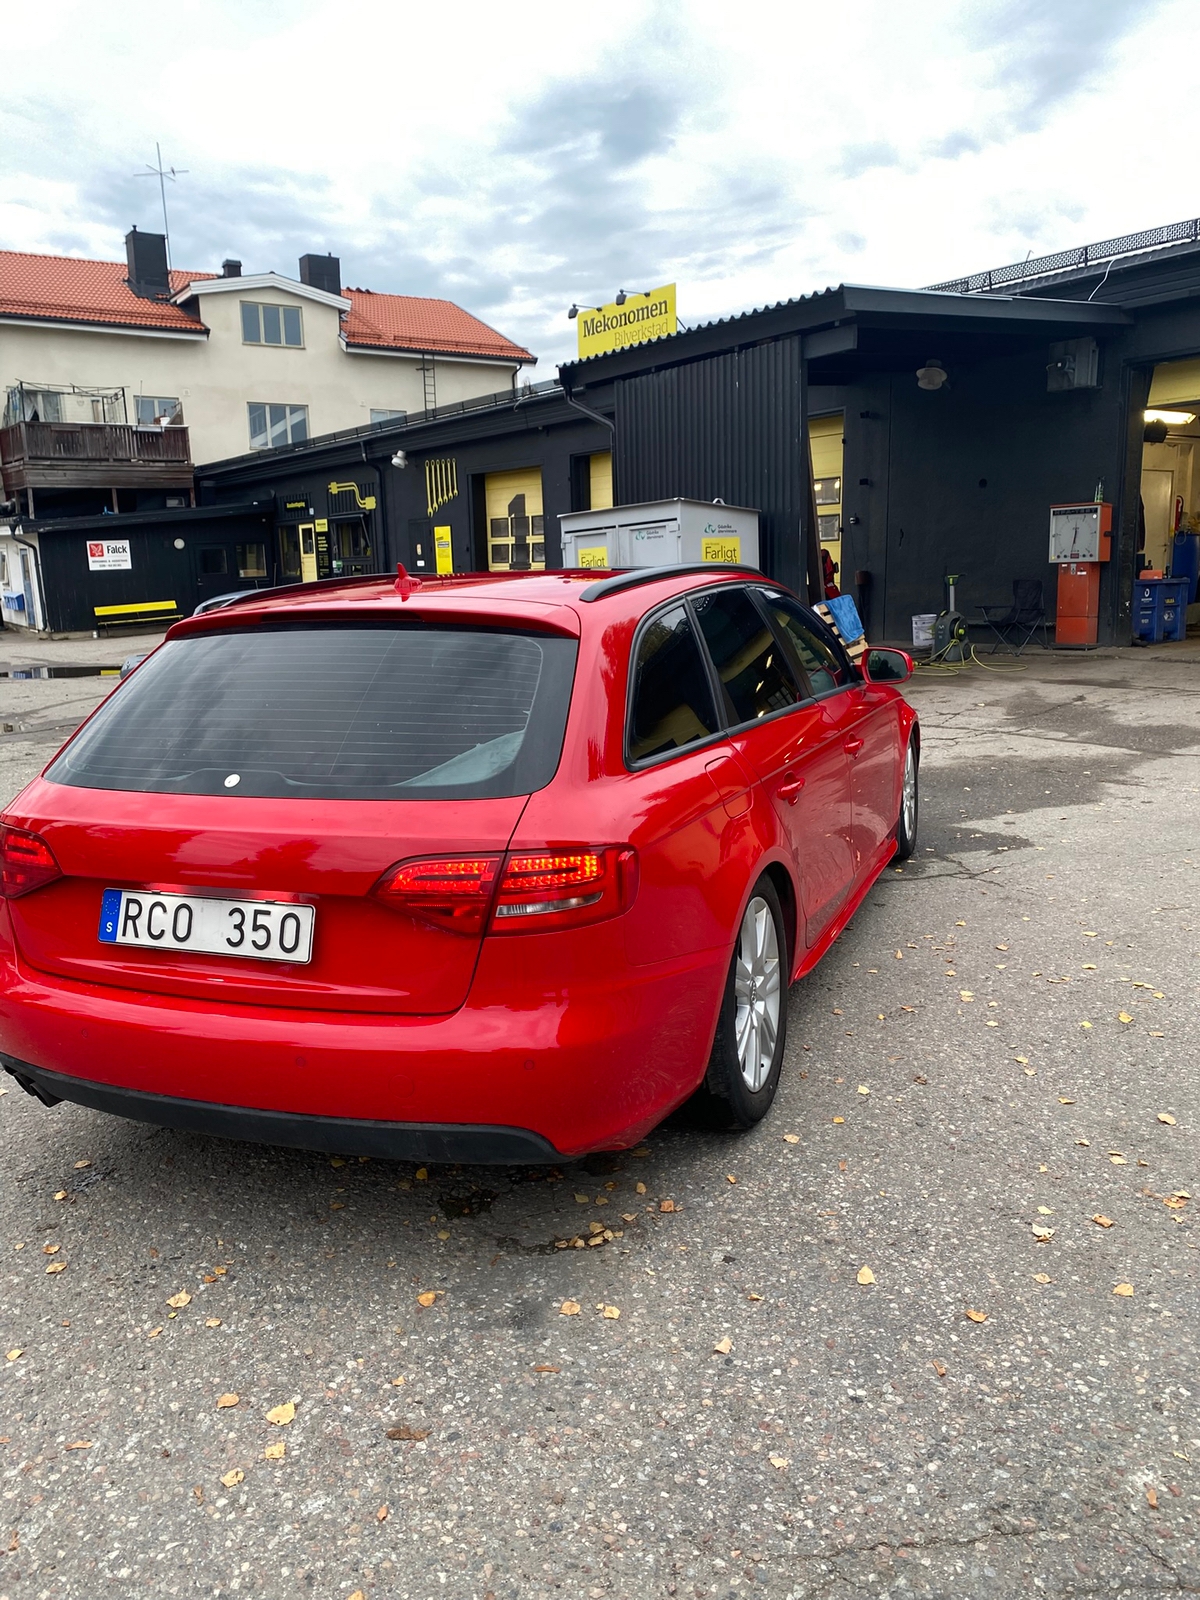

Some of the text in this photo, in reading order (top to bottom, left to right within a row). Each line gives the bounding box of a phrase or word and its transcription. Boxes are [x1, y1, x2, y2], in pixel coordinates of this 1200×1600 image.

[583, 300, 668, 337] Mekonomen
[614, 318, 668, 346] Bilverkstad
[508, 493, 531, 570] 1
[107, 545, 128, 554] Falck
[705, 545, 737, 560] Farligt
[581, 556, 605, 567] Farligt
[106, 921, 113, 933] S
[121, 898, 301, 953] RCO 350
